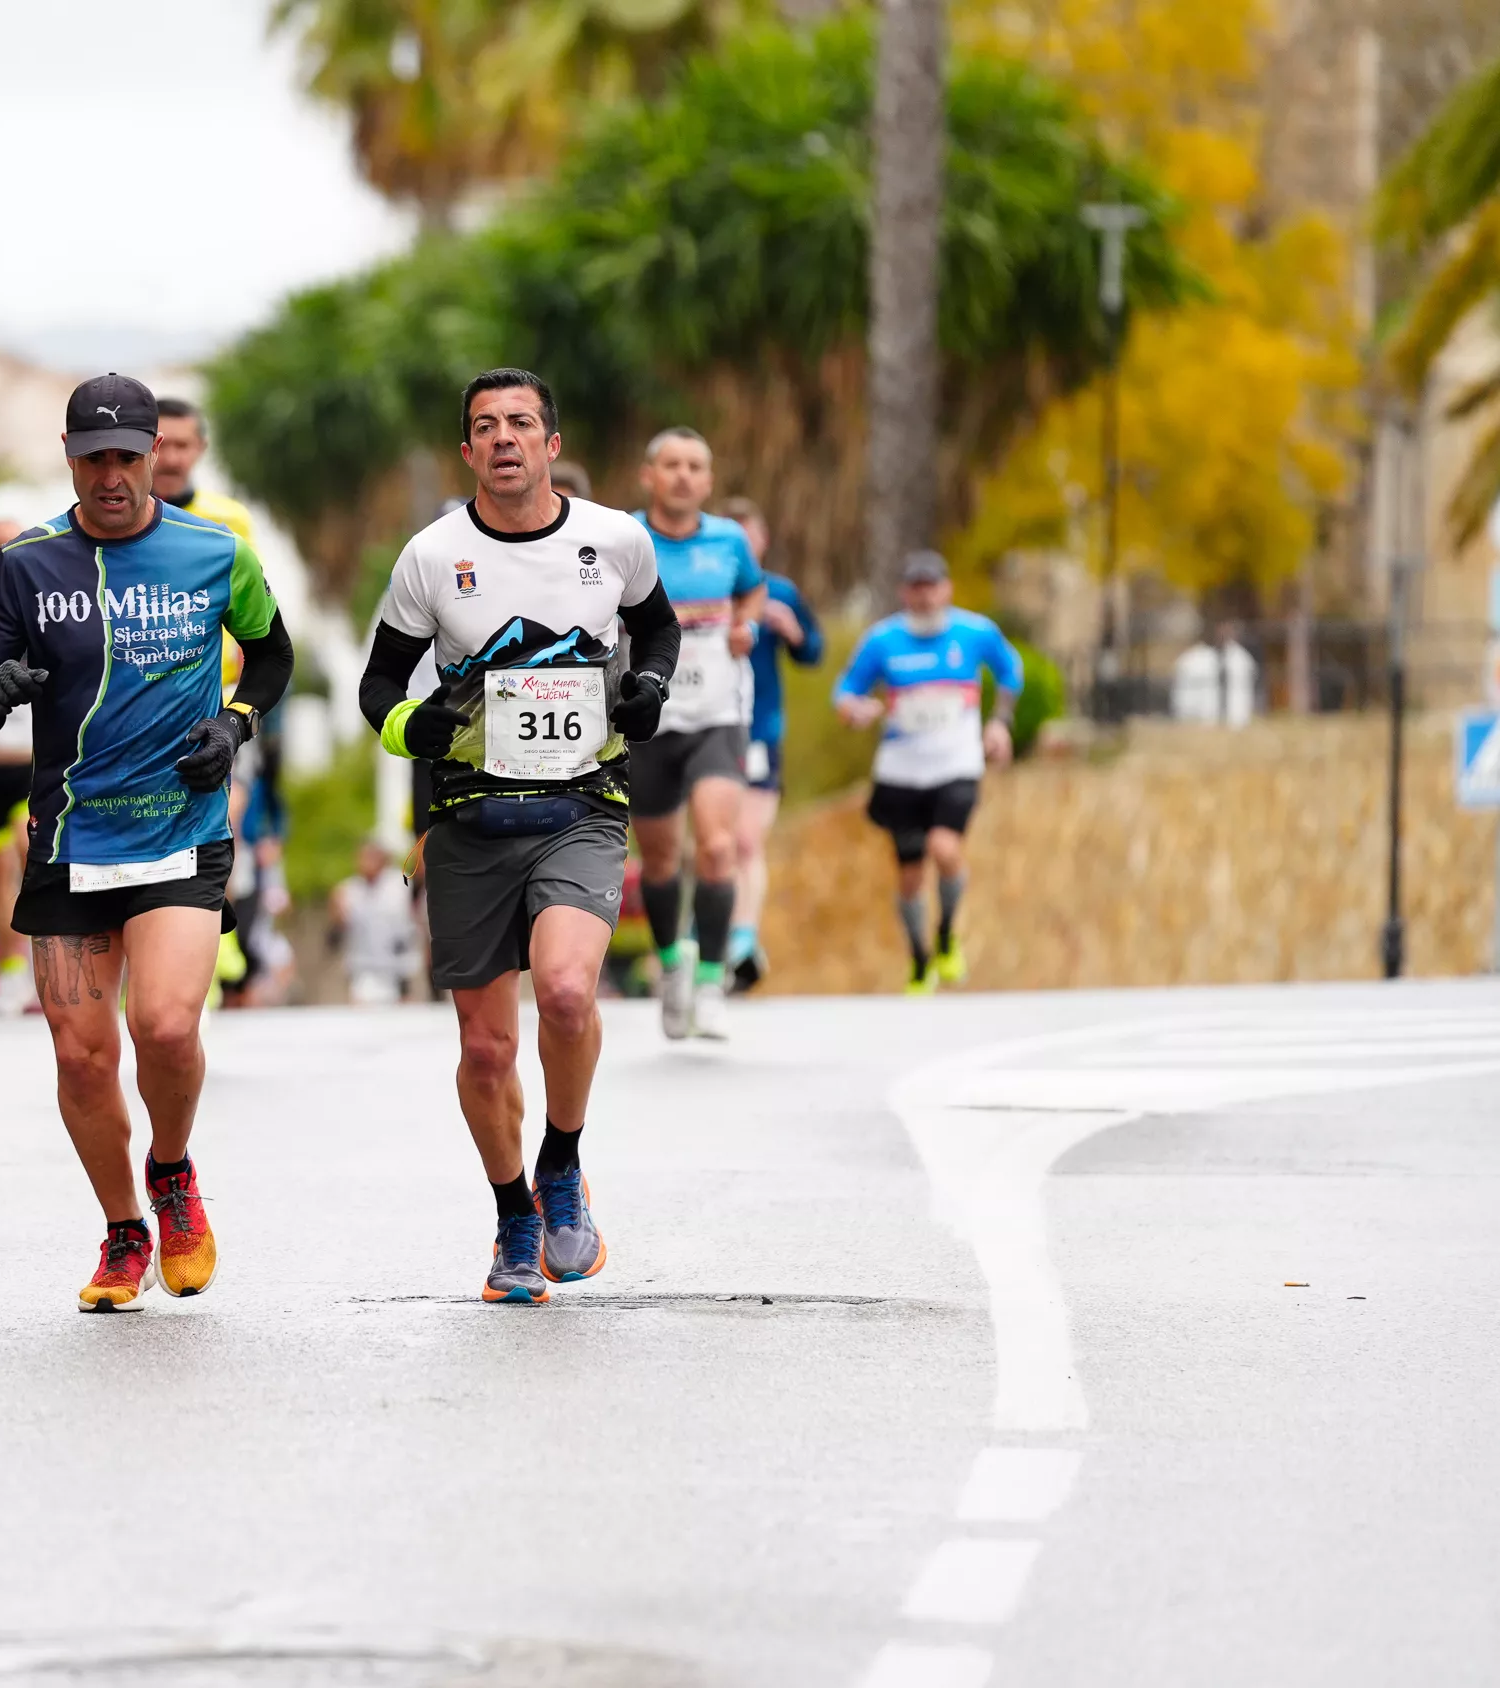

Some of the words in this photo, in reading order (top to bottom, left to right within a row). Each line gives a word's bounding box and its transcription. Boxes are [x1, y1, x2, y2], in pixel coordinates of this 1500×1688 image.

[35, 590, 92, 634] 100
[102, 583, 211, 630] Millas
[114, 626, 178, 648] Sierras
[181, 621, 206, 642] del
[536, 689, 574, 700] LUCENA
[518, 711, 582, 741] 316
[130, 790, 187, 807] BANDOLERA
